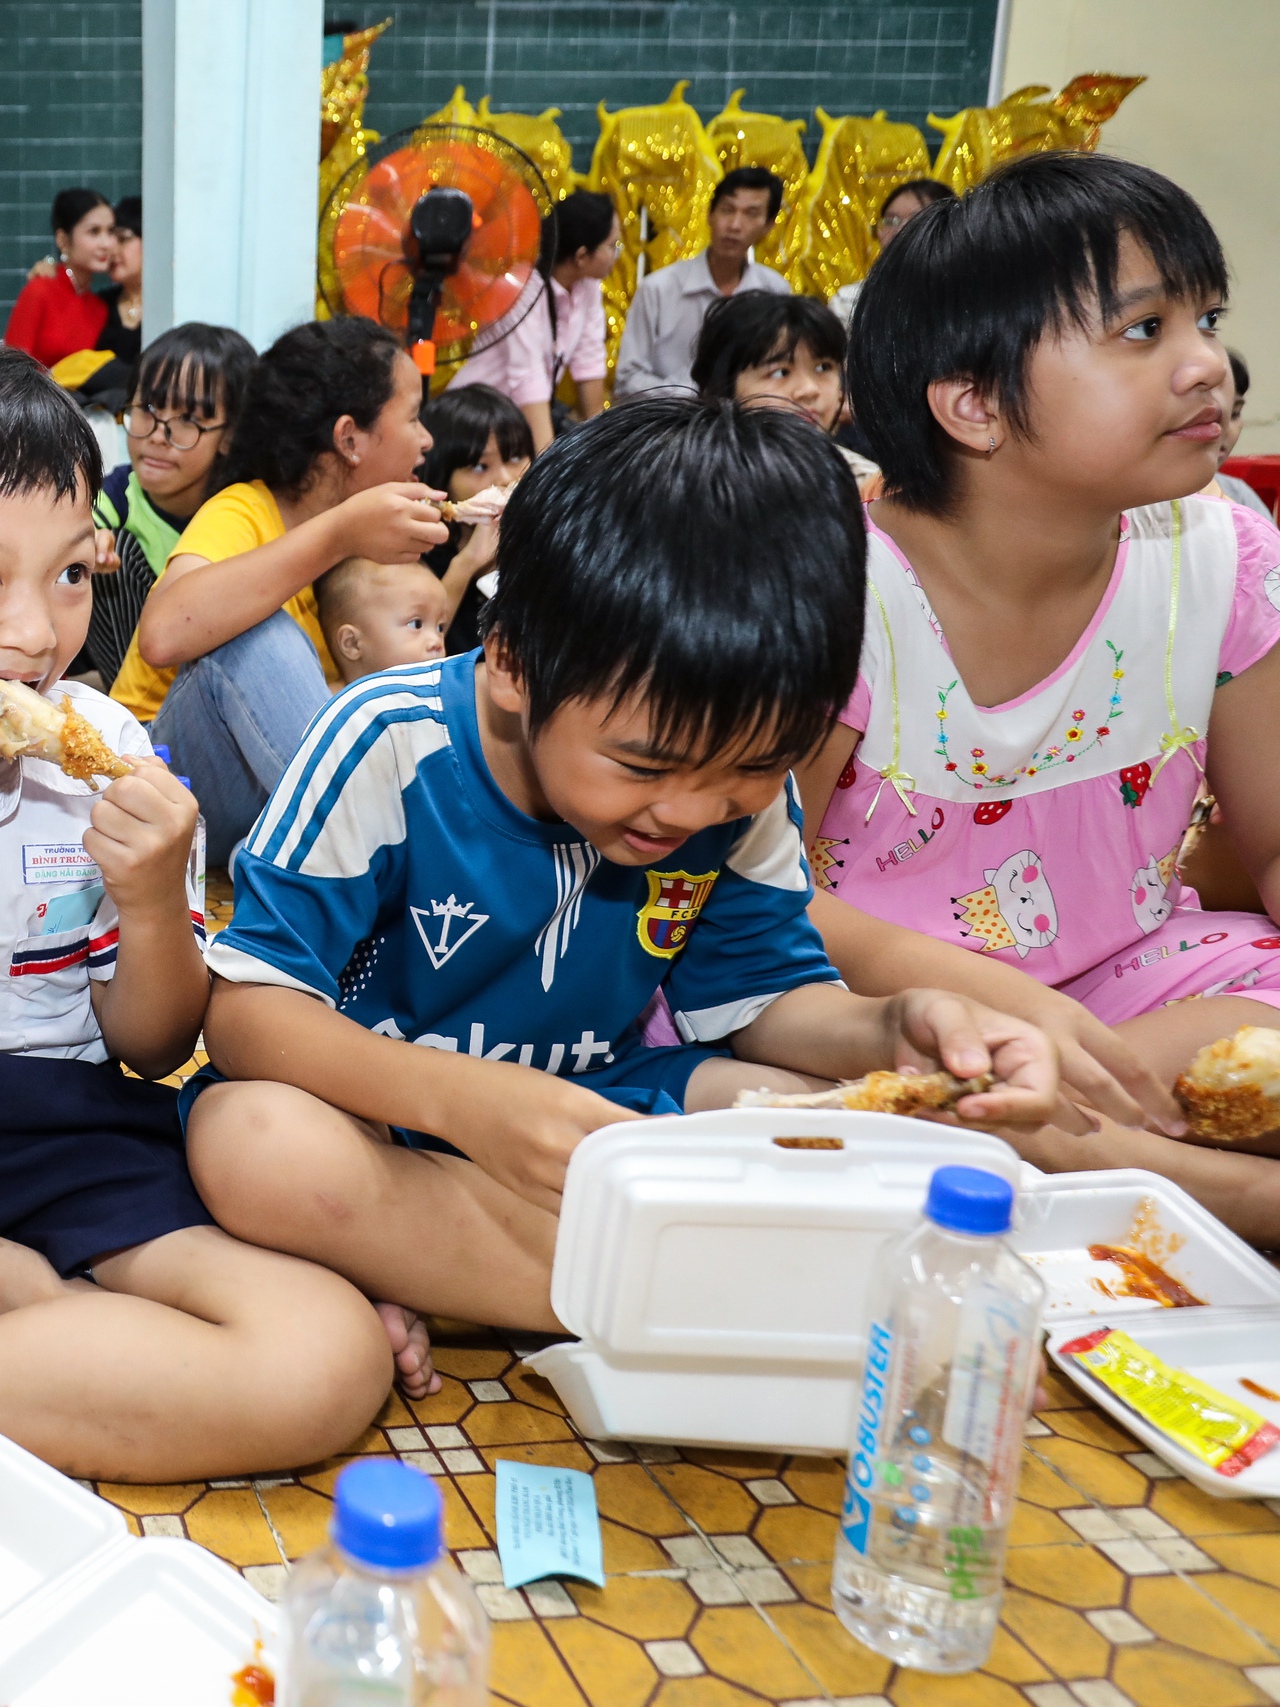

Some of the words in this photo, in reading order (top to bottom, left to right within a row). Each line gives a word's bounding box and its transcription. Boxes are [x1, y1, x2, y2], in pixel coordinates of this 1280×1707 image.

[32, 855, 57, 865] BÌNH
[875, 807, 945, 872] HELLO
[1114, 931, 1229, 979] HELLO
